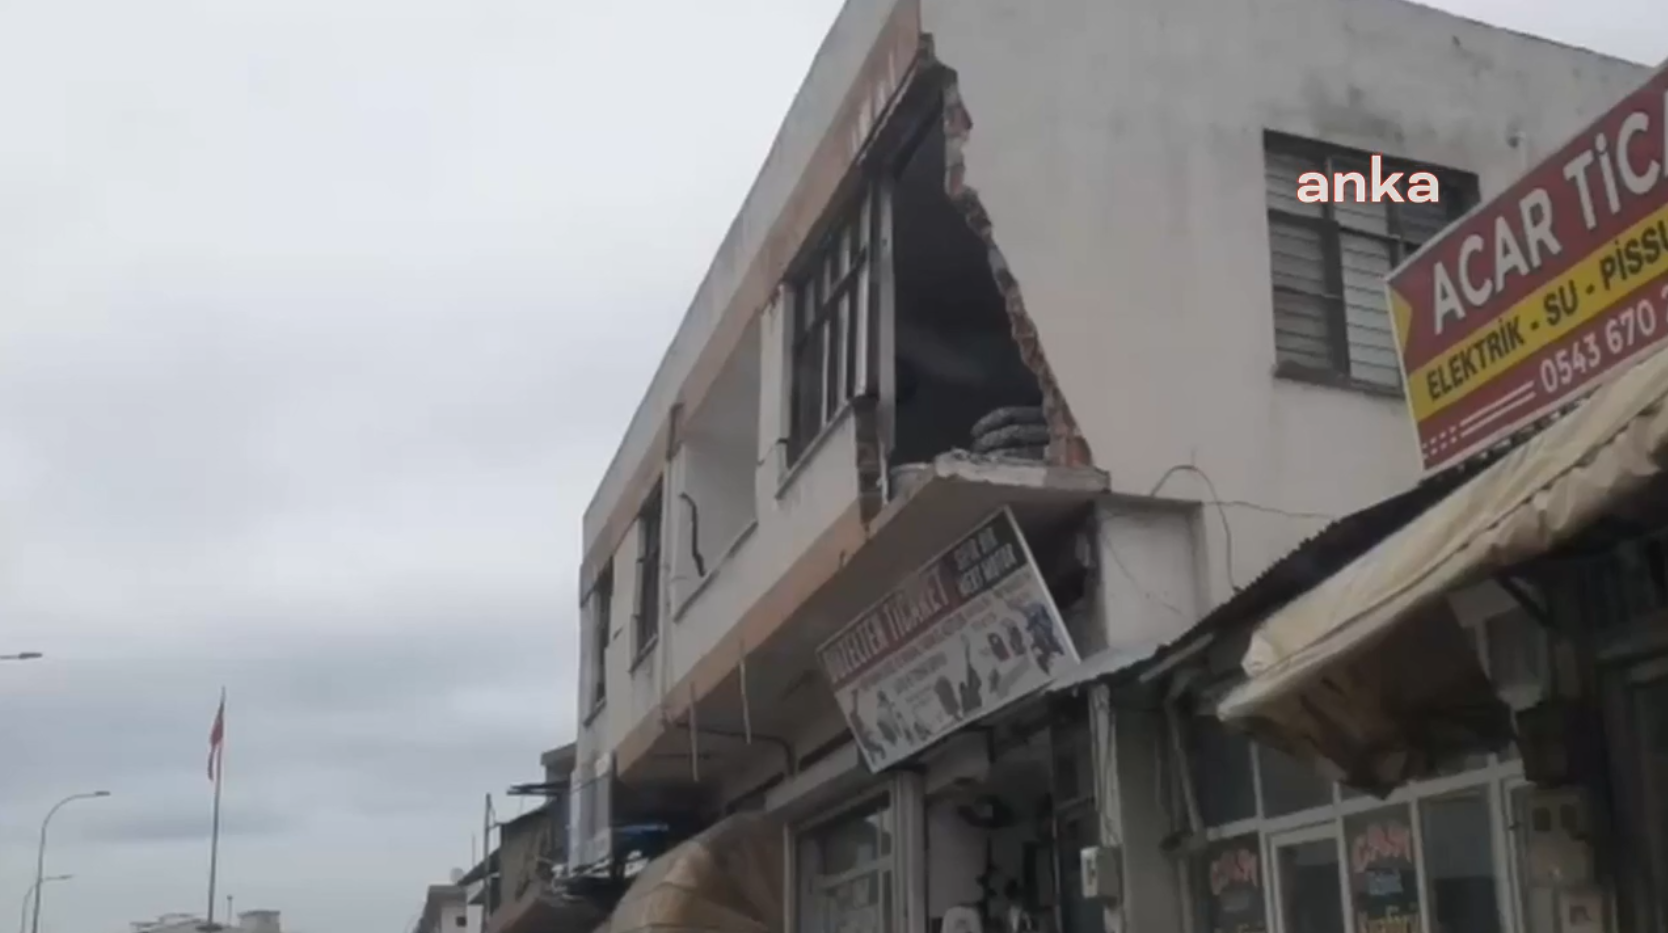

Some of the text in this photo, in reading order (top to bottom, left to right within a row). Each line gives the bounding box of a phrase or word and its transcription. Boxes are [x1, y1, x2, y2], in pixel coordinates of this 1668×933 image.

[1433, 91, 1668, 336] ACAR TİC
[1425, 316, 1525, 402] ELEKTRİK
[1543, 279, 1579, 327] SU
[1540, 304, 1656, 394] 0543 670
